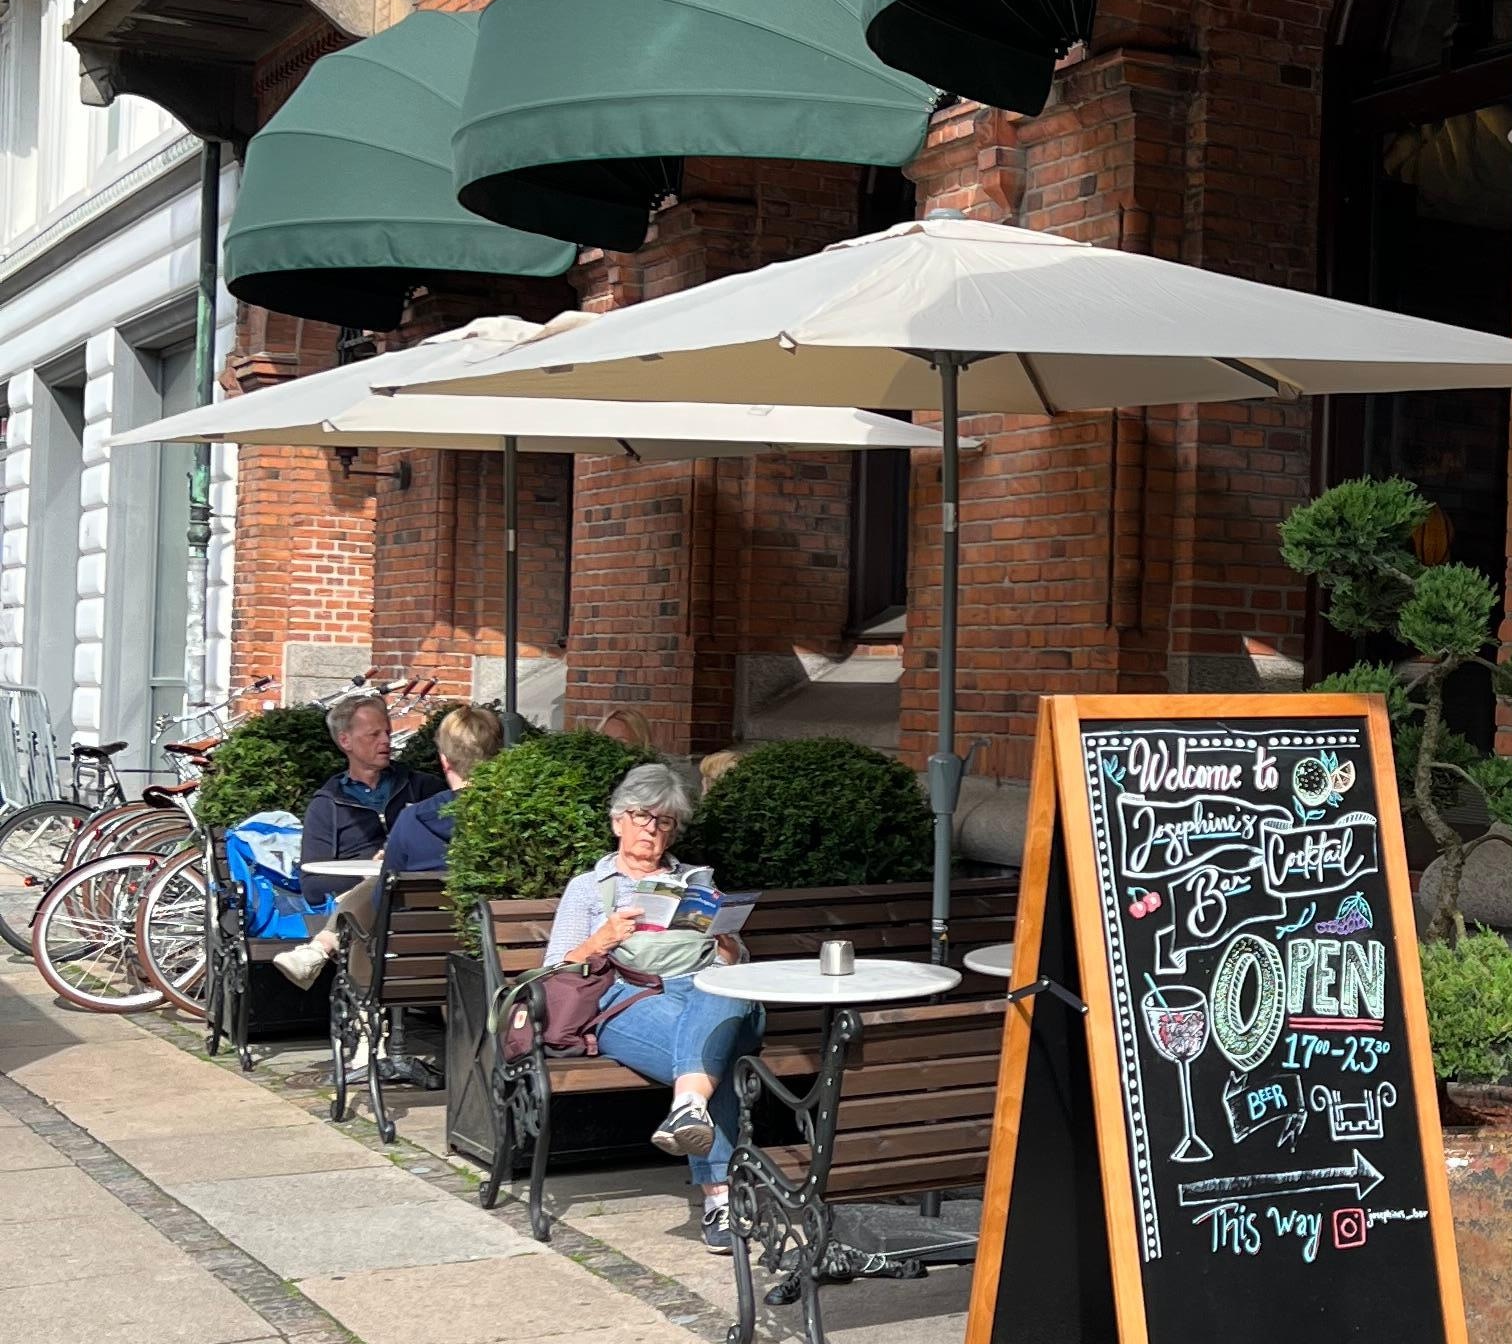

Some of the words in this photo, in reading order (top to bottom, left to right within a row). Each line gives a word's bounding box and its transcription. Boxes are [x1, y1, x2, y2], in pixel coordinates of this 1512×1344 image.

[1128, 737, 1243, 793] Welcome
[1253, 746, 1280, 791] to
[1129, 800, 1258, 873] Josephine's
[1268, 827, 1365, 886] Cocktail
[1186, 867, 1251, 938] Bar
[1210, 933, 1386, 1072] OPEN
[1247, 1084, 1289, 1121] BEER
[1192, 1202, 1262, 1256] This
